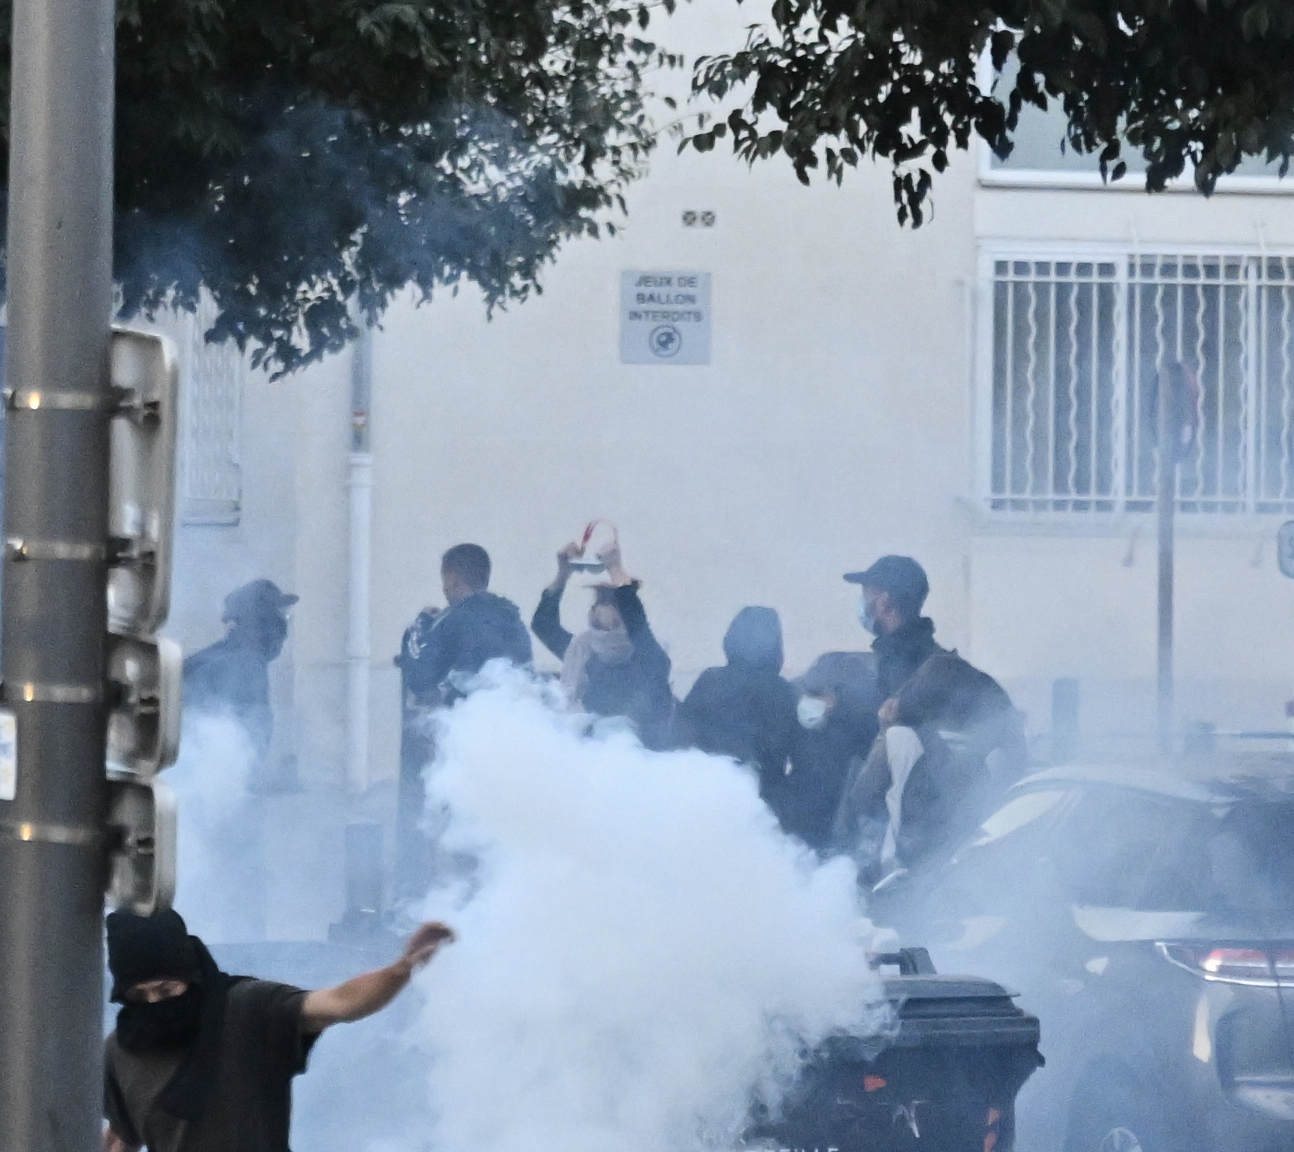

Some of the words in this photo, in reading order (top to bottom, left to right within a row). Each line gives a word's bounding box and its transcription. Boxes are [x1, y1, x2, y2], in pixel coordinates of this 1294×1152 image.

[635, 275, 673, 287] JEUX
[677, 276, 698, 288] DE
[635, 292, 697, 304] BALLON
[628, 310, 703, 322] INTERDITS
